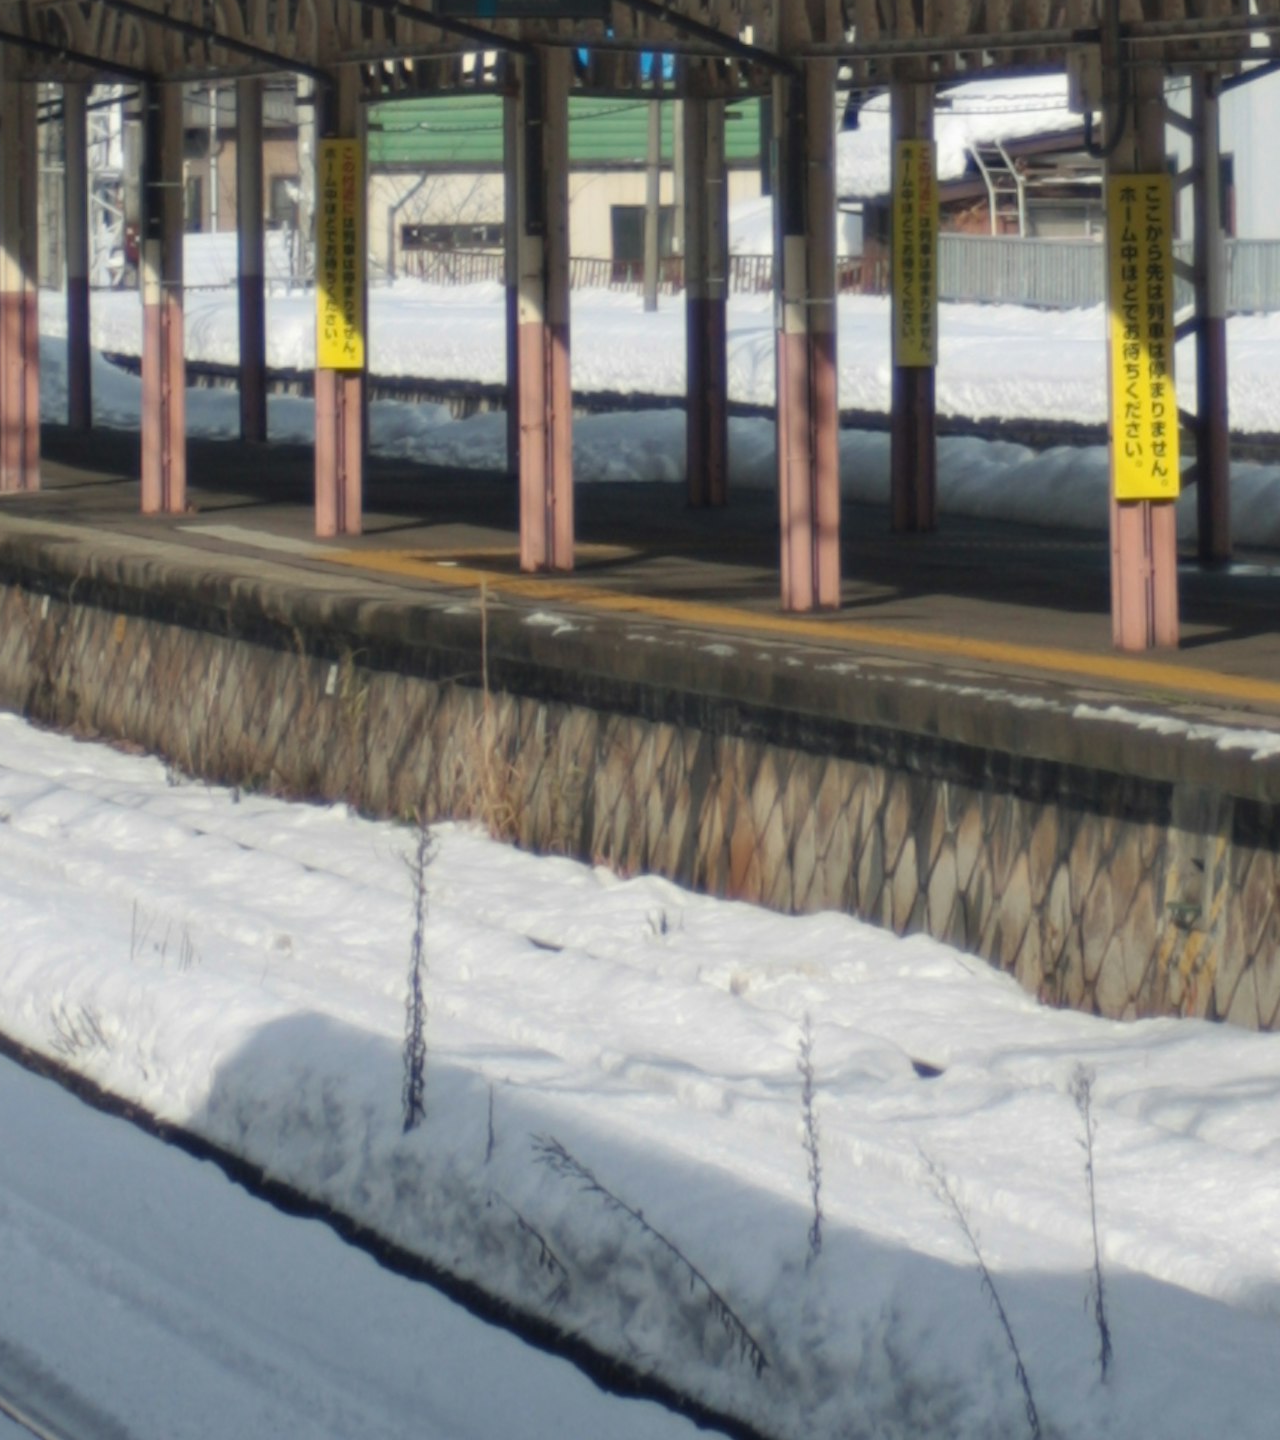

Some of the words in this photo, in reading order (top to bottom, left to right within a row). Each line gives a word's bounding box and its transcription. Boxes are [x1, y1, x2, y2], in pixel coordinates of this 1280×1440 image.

[1118, 186, 1143, 467] ホーム中ほどでお待ちください。
[1144, 185, 1168, 487] ここから先は列車は停まりません。
